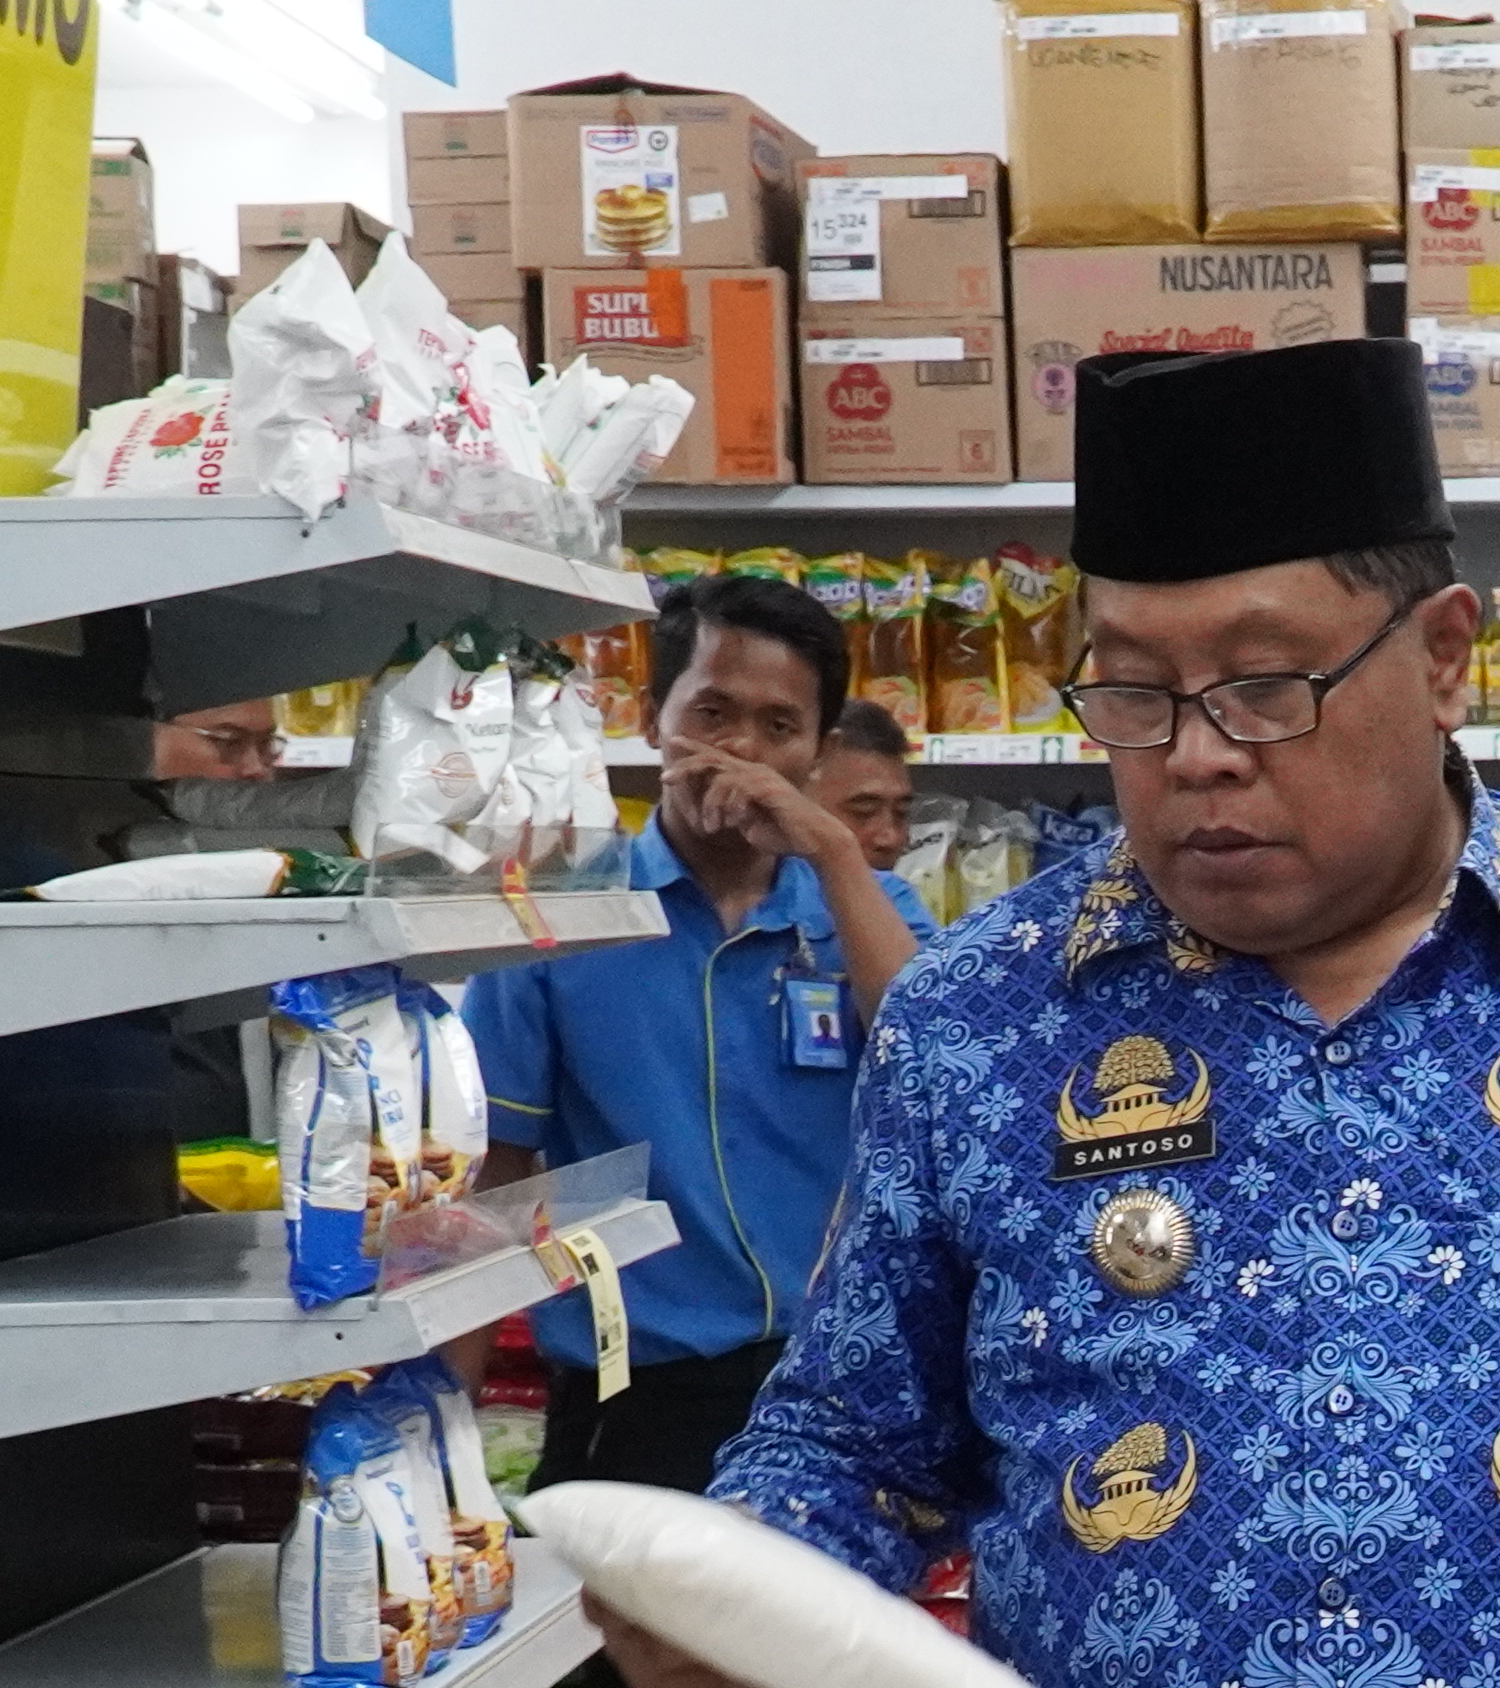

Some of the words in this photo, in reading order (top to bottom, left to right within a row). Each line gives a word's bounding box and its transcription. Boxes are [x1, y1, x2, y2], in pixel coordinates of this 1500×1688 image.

[1429, 199, 1478, 218] ABC
[1159, 254, 1334, 292] NUSANTARA
[584, 316, 659, 338] BUBU
[835, 388, 886, 407] ABC
[199, 437, 229, 495] ROSE
[1073, 1132, 1196, 1168] SANTOSO
